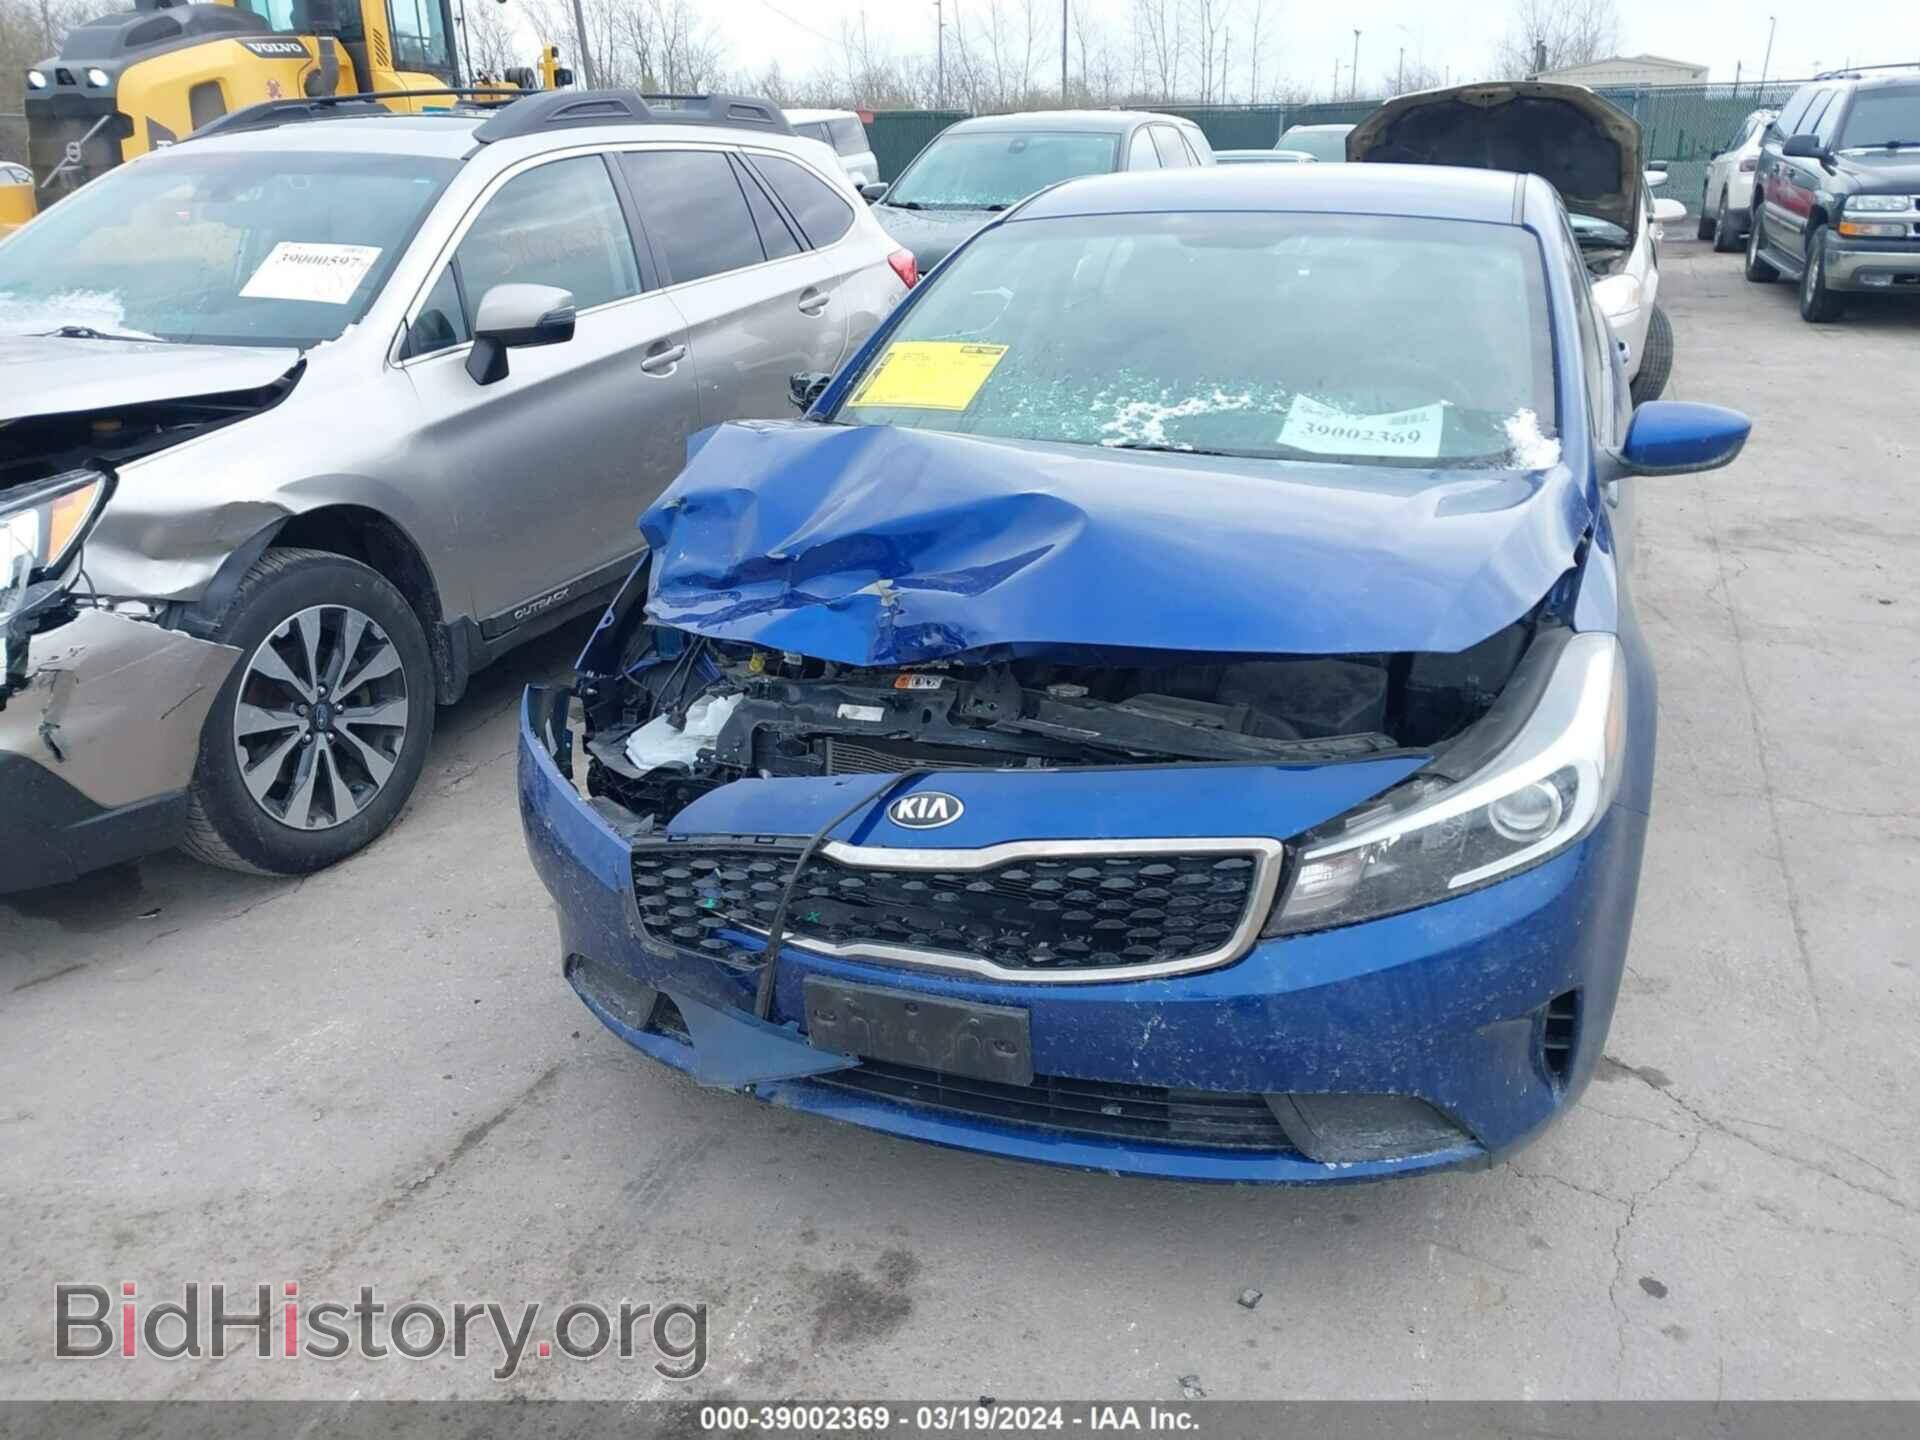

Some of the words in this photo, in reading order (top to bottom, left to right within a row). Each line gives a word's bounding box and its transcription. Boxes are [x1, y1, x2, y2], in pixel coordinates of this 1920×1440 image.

[246, 43, 302, 53] VOLVO
[1303, 421, 1421, 444] 39002369
[514, 588, 569, 620] OUTBACK
[896, 797, 948, 819] KIA
